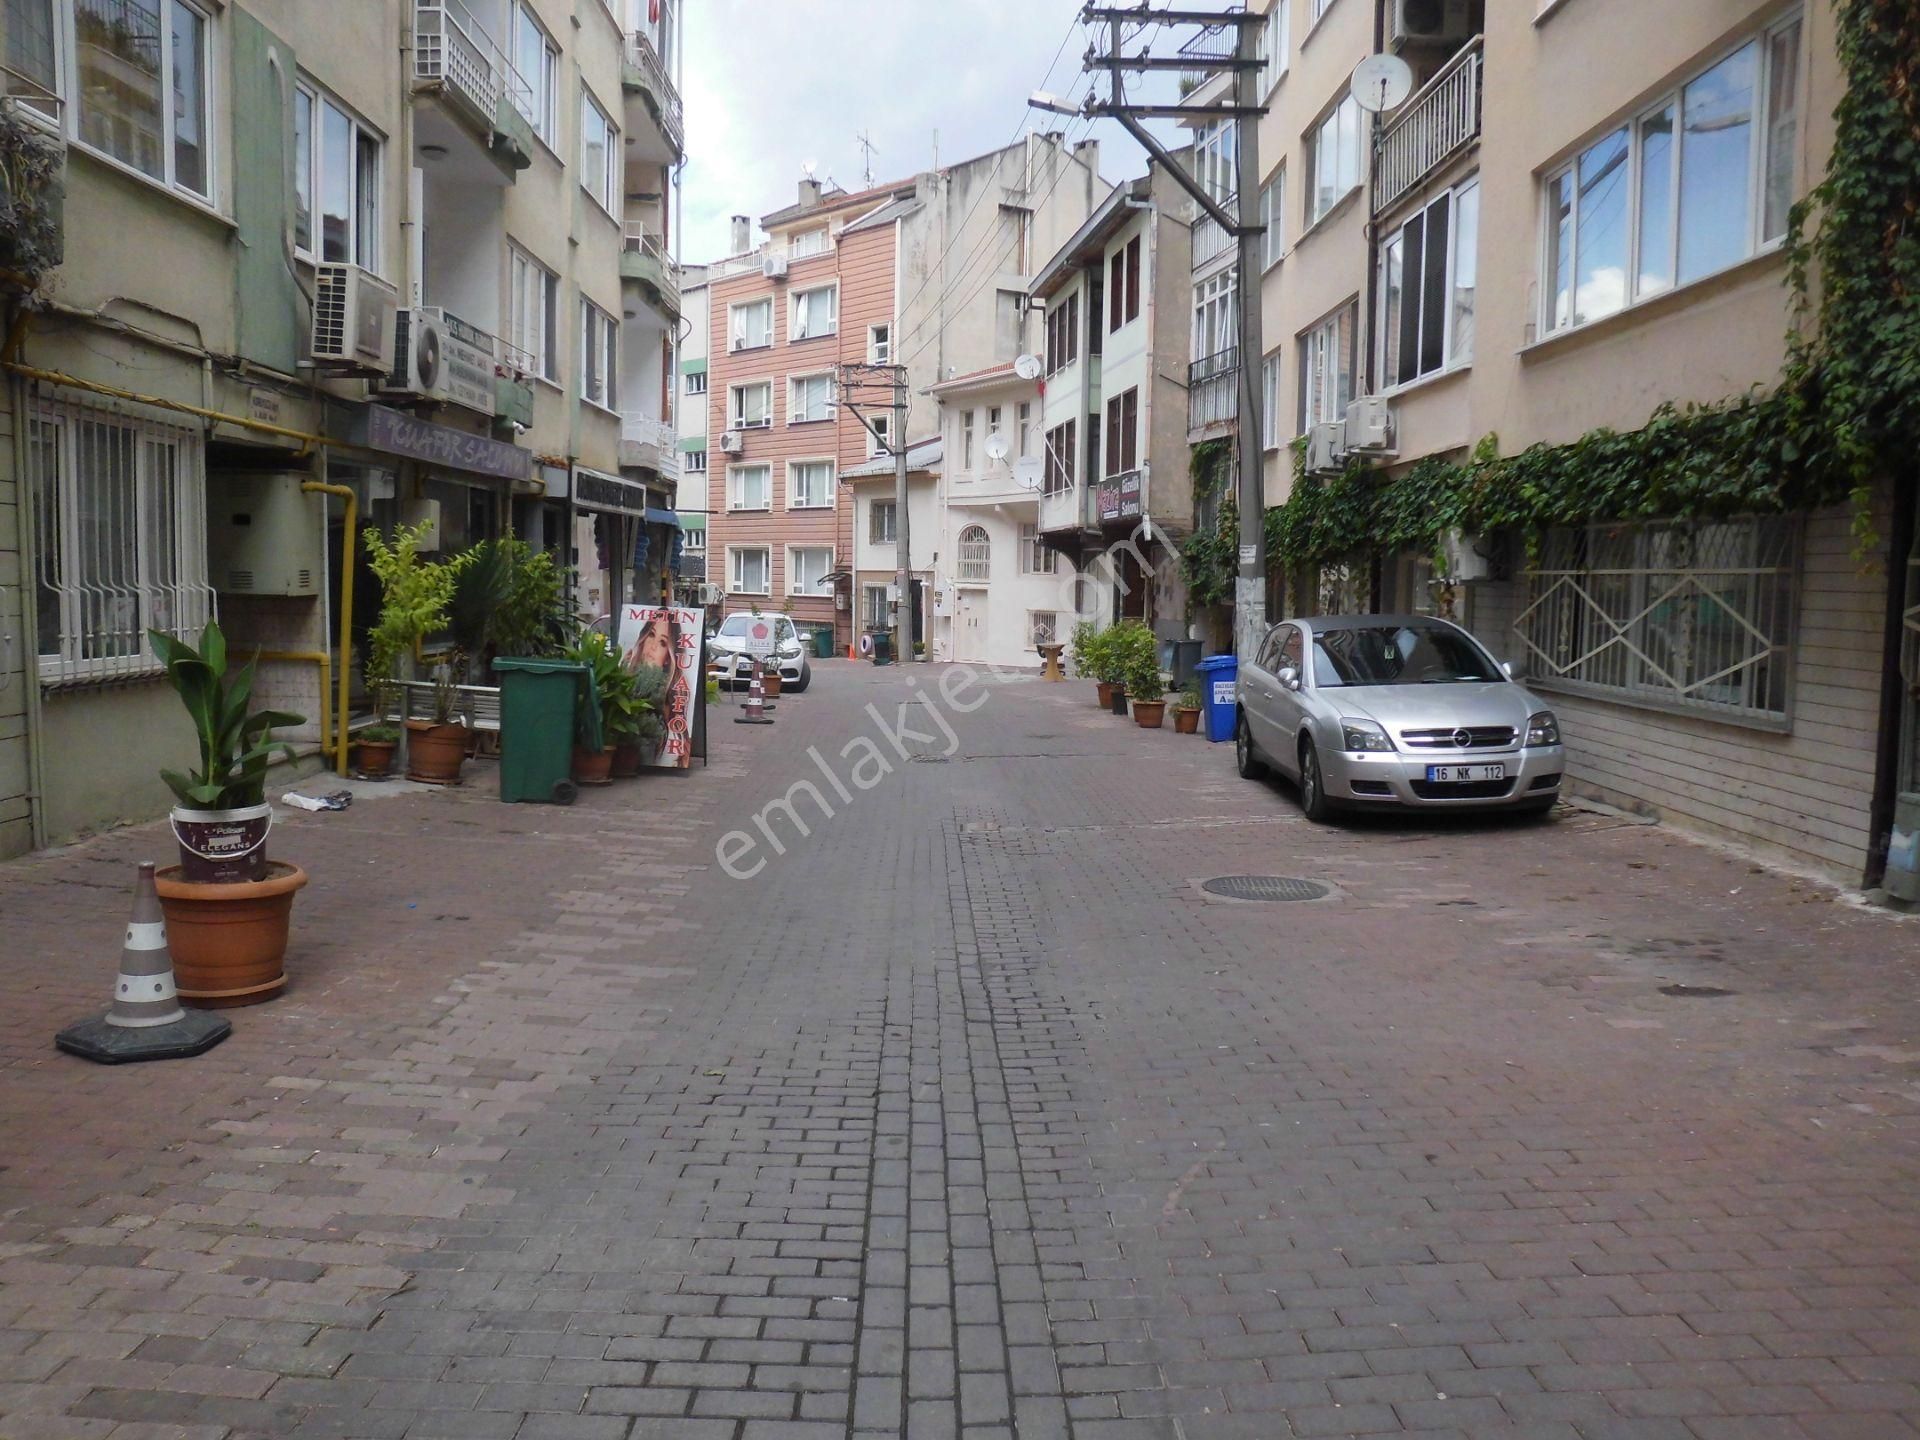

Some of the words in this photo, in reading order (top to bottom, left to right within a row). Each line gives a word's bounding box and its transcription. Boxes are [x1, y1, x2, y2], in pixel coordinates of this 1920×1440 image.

[1220, 695, 1227, 703] A
[1436, 767, 1448, 780] 16
[1457, 767, 1471, 780] NK
[1484, 766, 1502, 779] 112
[200, 842, 251, 851] ELEGANS
